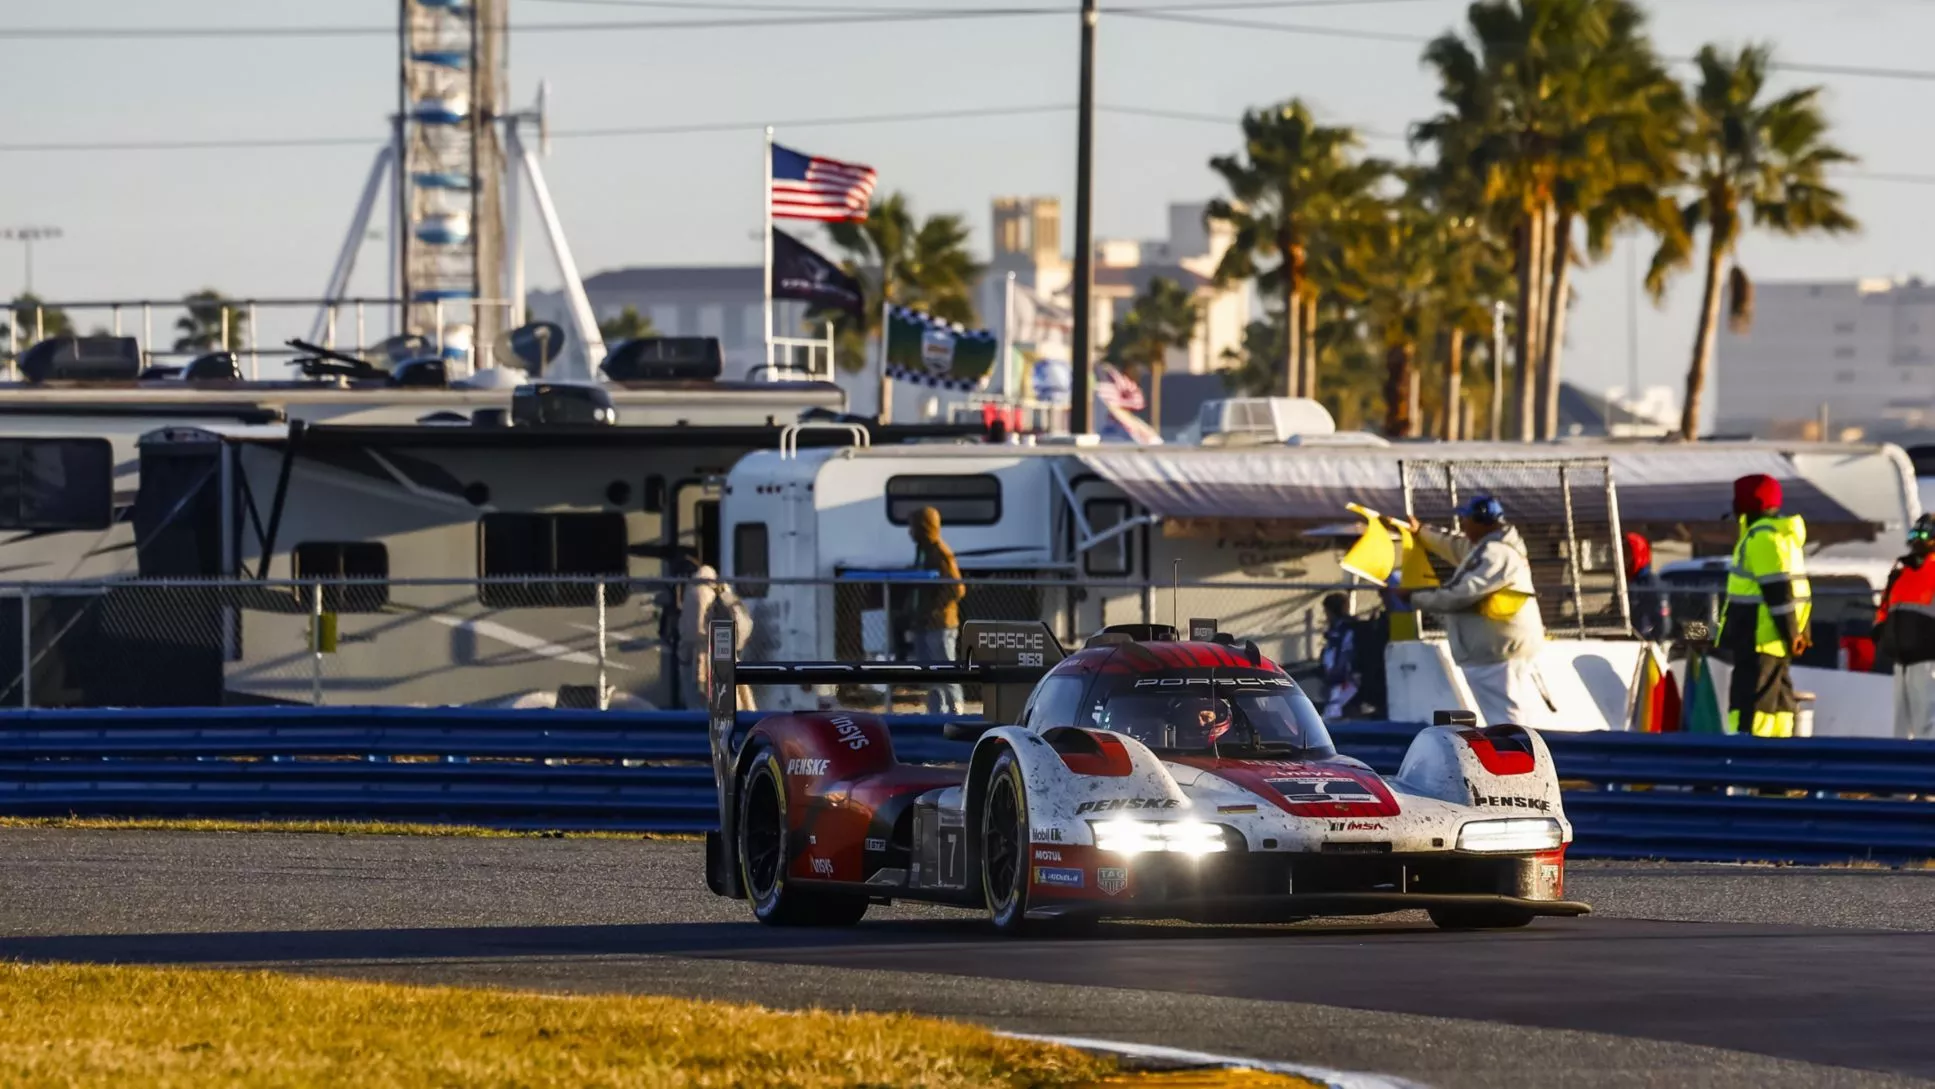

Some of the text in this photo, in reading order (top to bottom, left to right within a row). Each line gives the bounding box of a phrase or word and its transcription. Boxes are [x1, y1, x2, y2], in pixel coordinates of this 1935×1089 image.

[978, 632, 1043, 649] PORSCHE
[1018, 652, 1044, 667] 963
[1134, 678, 1293, 688] PORSCHE
[786, 758, 831, 776] PENSKE
[1297, 781, 1332, 795] 7
[1075, 798, 1180, 816] PENSKE
[1471, 796, 1550, 812] PENSKE
[1032, 827, 1050, 842] Mobil
[1346, 822, 1385, 832] IMSA
[947, 834, 957, 878] 7
[1035, 849, 1062, 862] MOTUL
[1101, 870, 1125, 879] TAG
